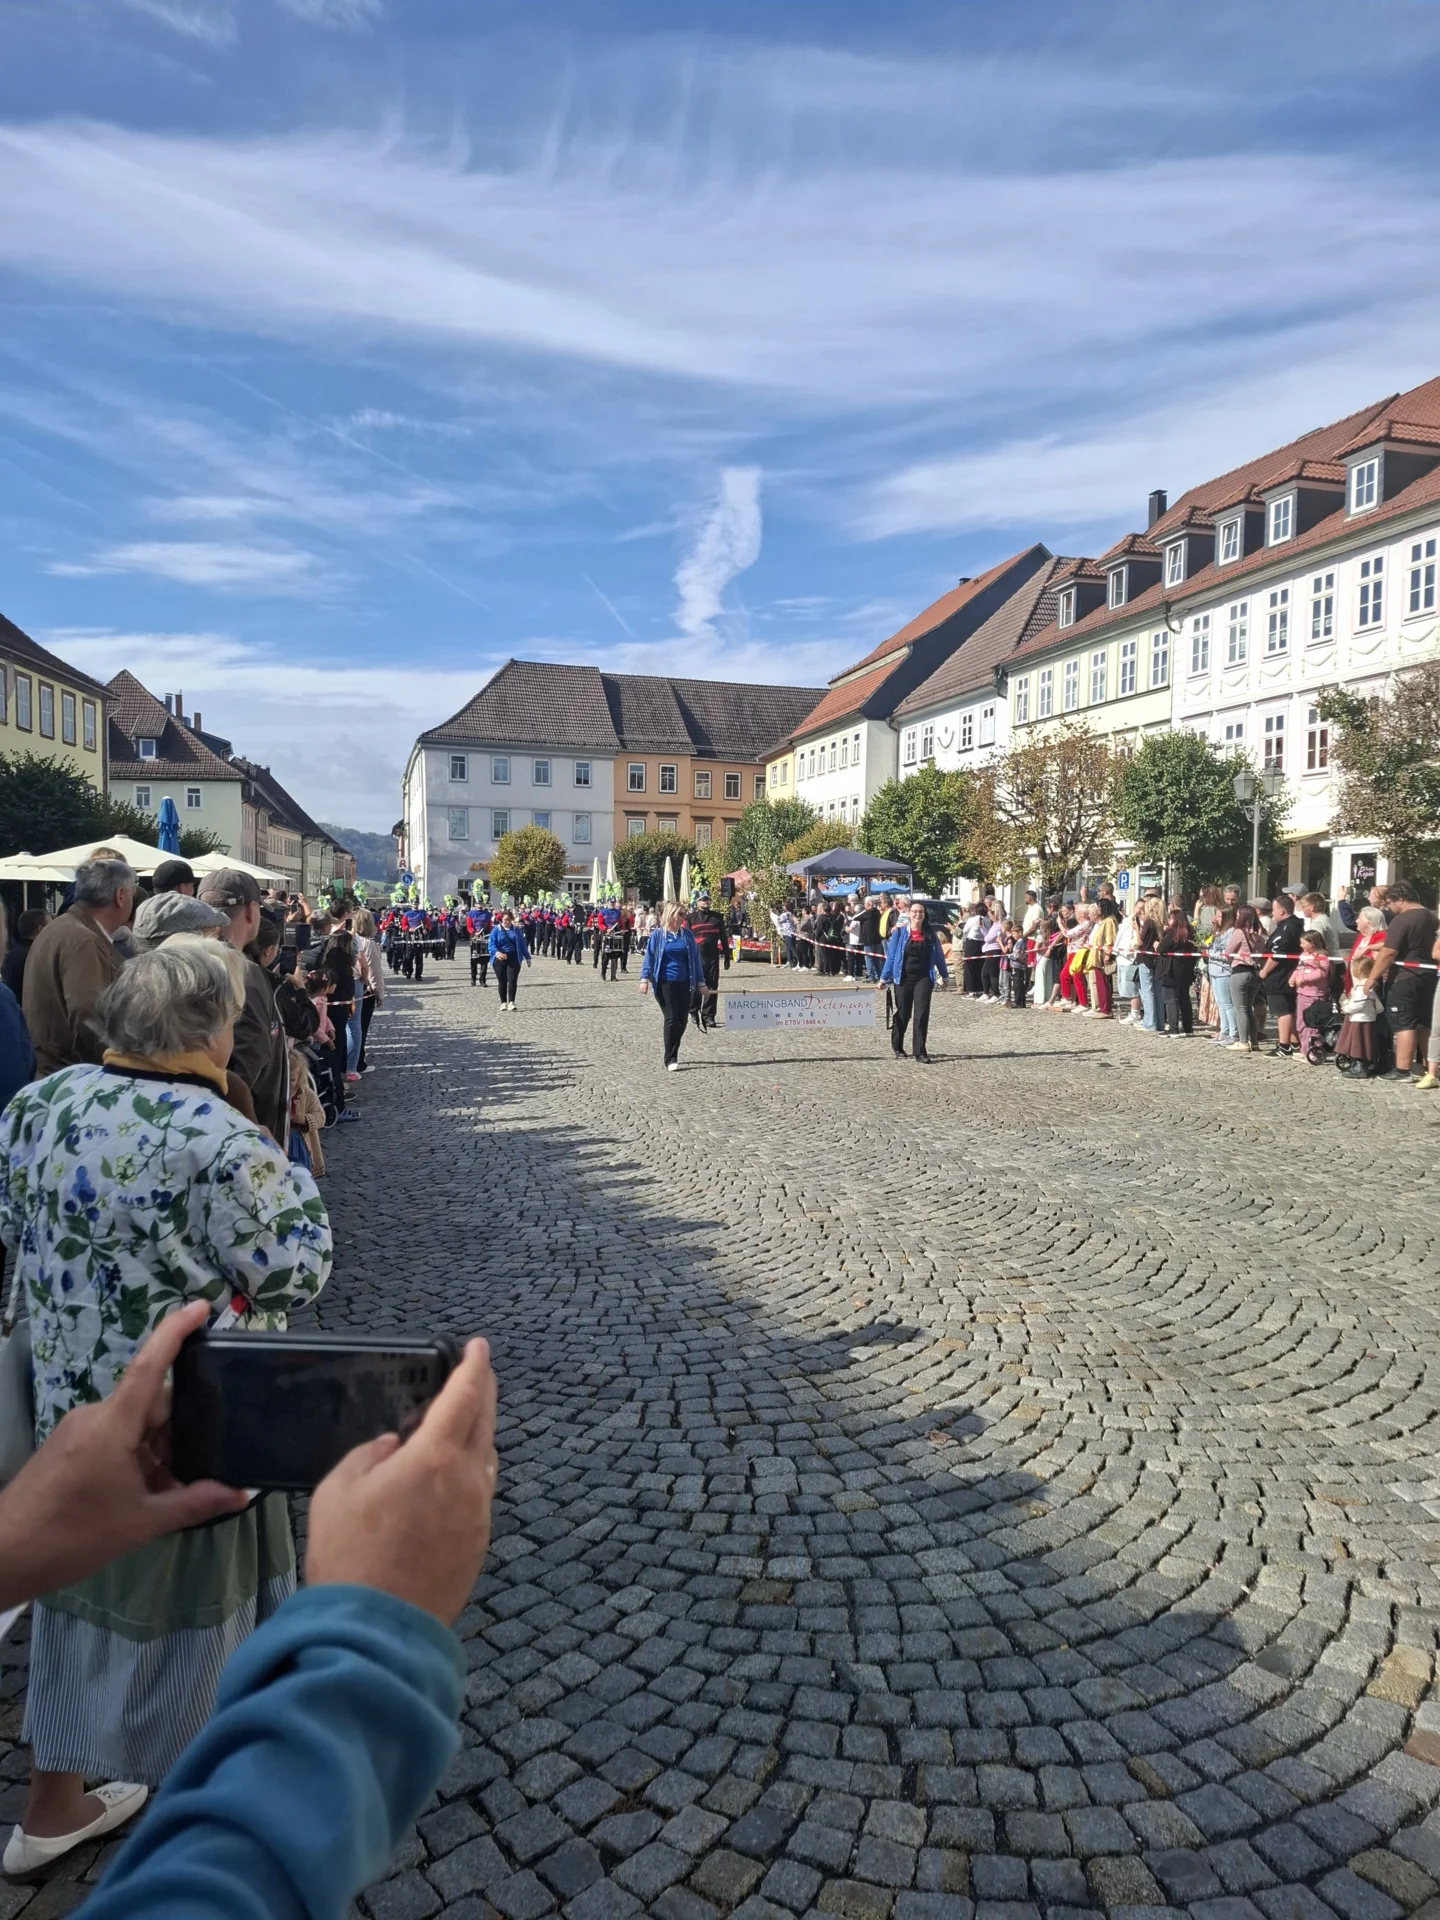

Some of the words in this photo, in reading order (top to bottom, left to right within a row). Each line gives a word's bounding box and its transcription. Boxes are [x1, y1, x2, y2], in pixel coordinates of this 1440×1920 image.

[1120, 874, 1128, 888] P
[728, 998, 808, 1010] MARCHINGBAND
[729, 1011, 815, 1020] ESCHWEGE
[837, 1009, 872, 1017] 1907
